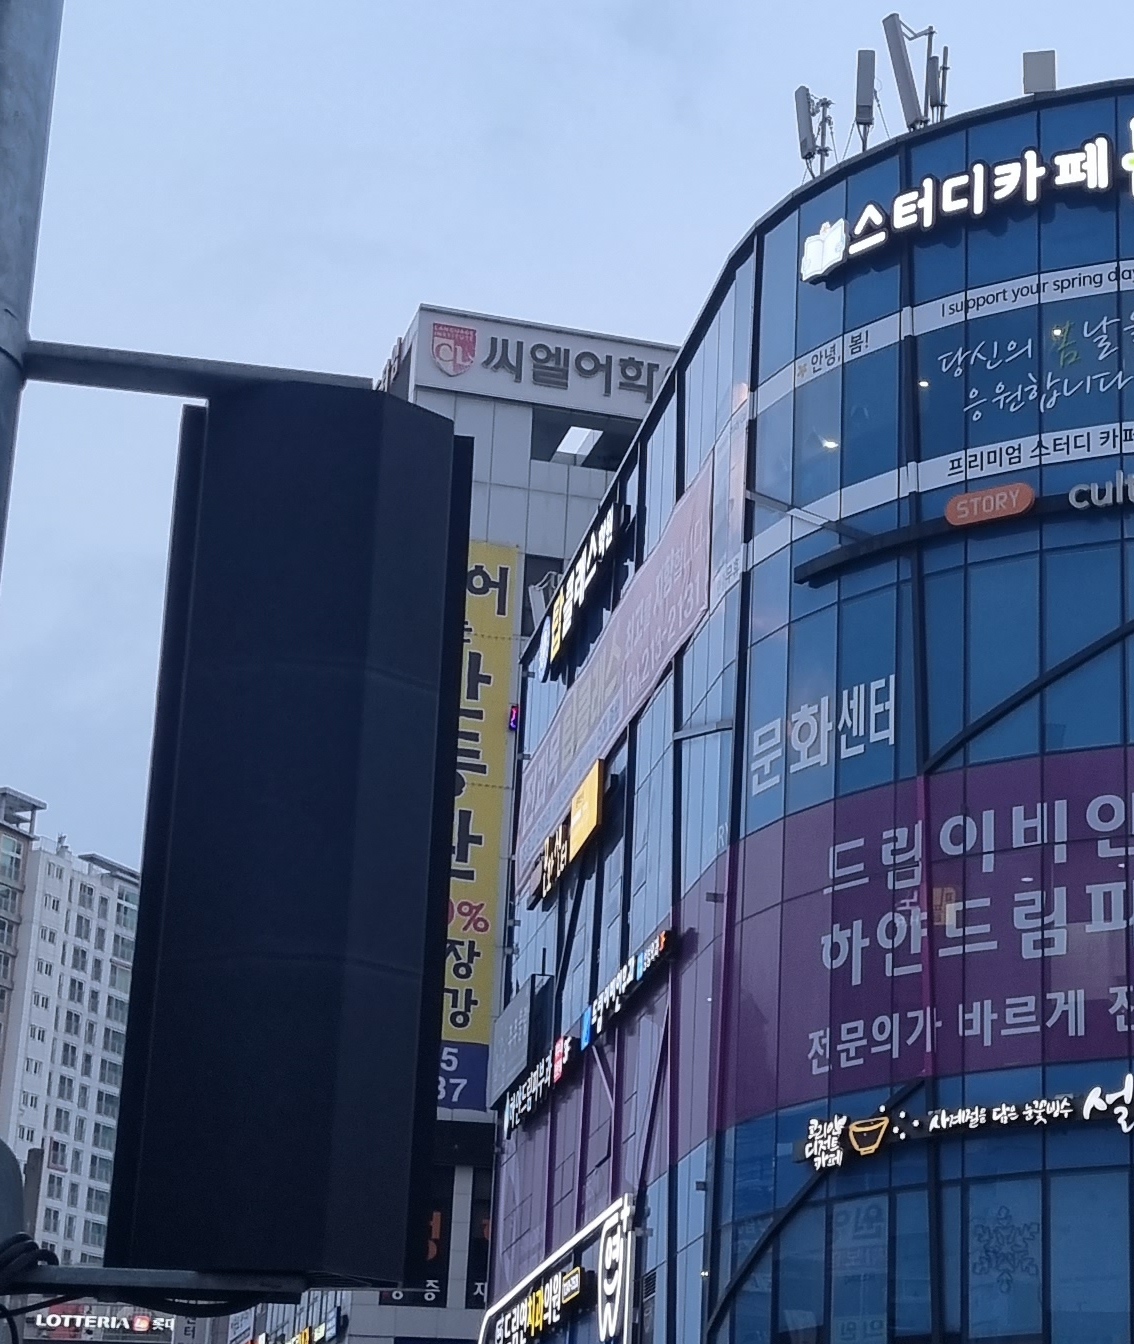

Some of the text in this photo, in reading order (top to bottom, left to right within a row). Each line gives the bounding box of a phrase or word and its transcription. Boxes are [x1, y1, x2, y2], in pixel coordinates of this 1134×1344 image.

[848, 137, 1109, 254] 스터디카페
[947, 290, 1008, 318] support
[1011, 281, 1048, 305] your
[1052, 269, 1104, 298] spring
[481, 336, 672, 404] 씨엘어학
[937, 335, 1034, 379] 당신의
[962, 367, 1134, 423] 응원합니다
[948, 441, 1023, 478] 프리미엄
[1029, 433, 1091, 461] 스터디
[956, 490, 1021, 518] STORY
[750, 674, 896, 797] 문화센터
[808, 1007, 942, 1075] 전문의가
[957, 987, 1086, 1047] 바르게
[35, 1314, 130, 1330] LOTTERIA
